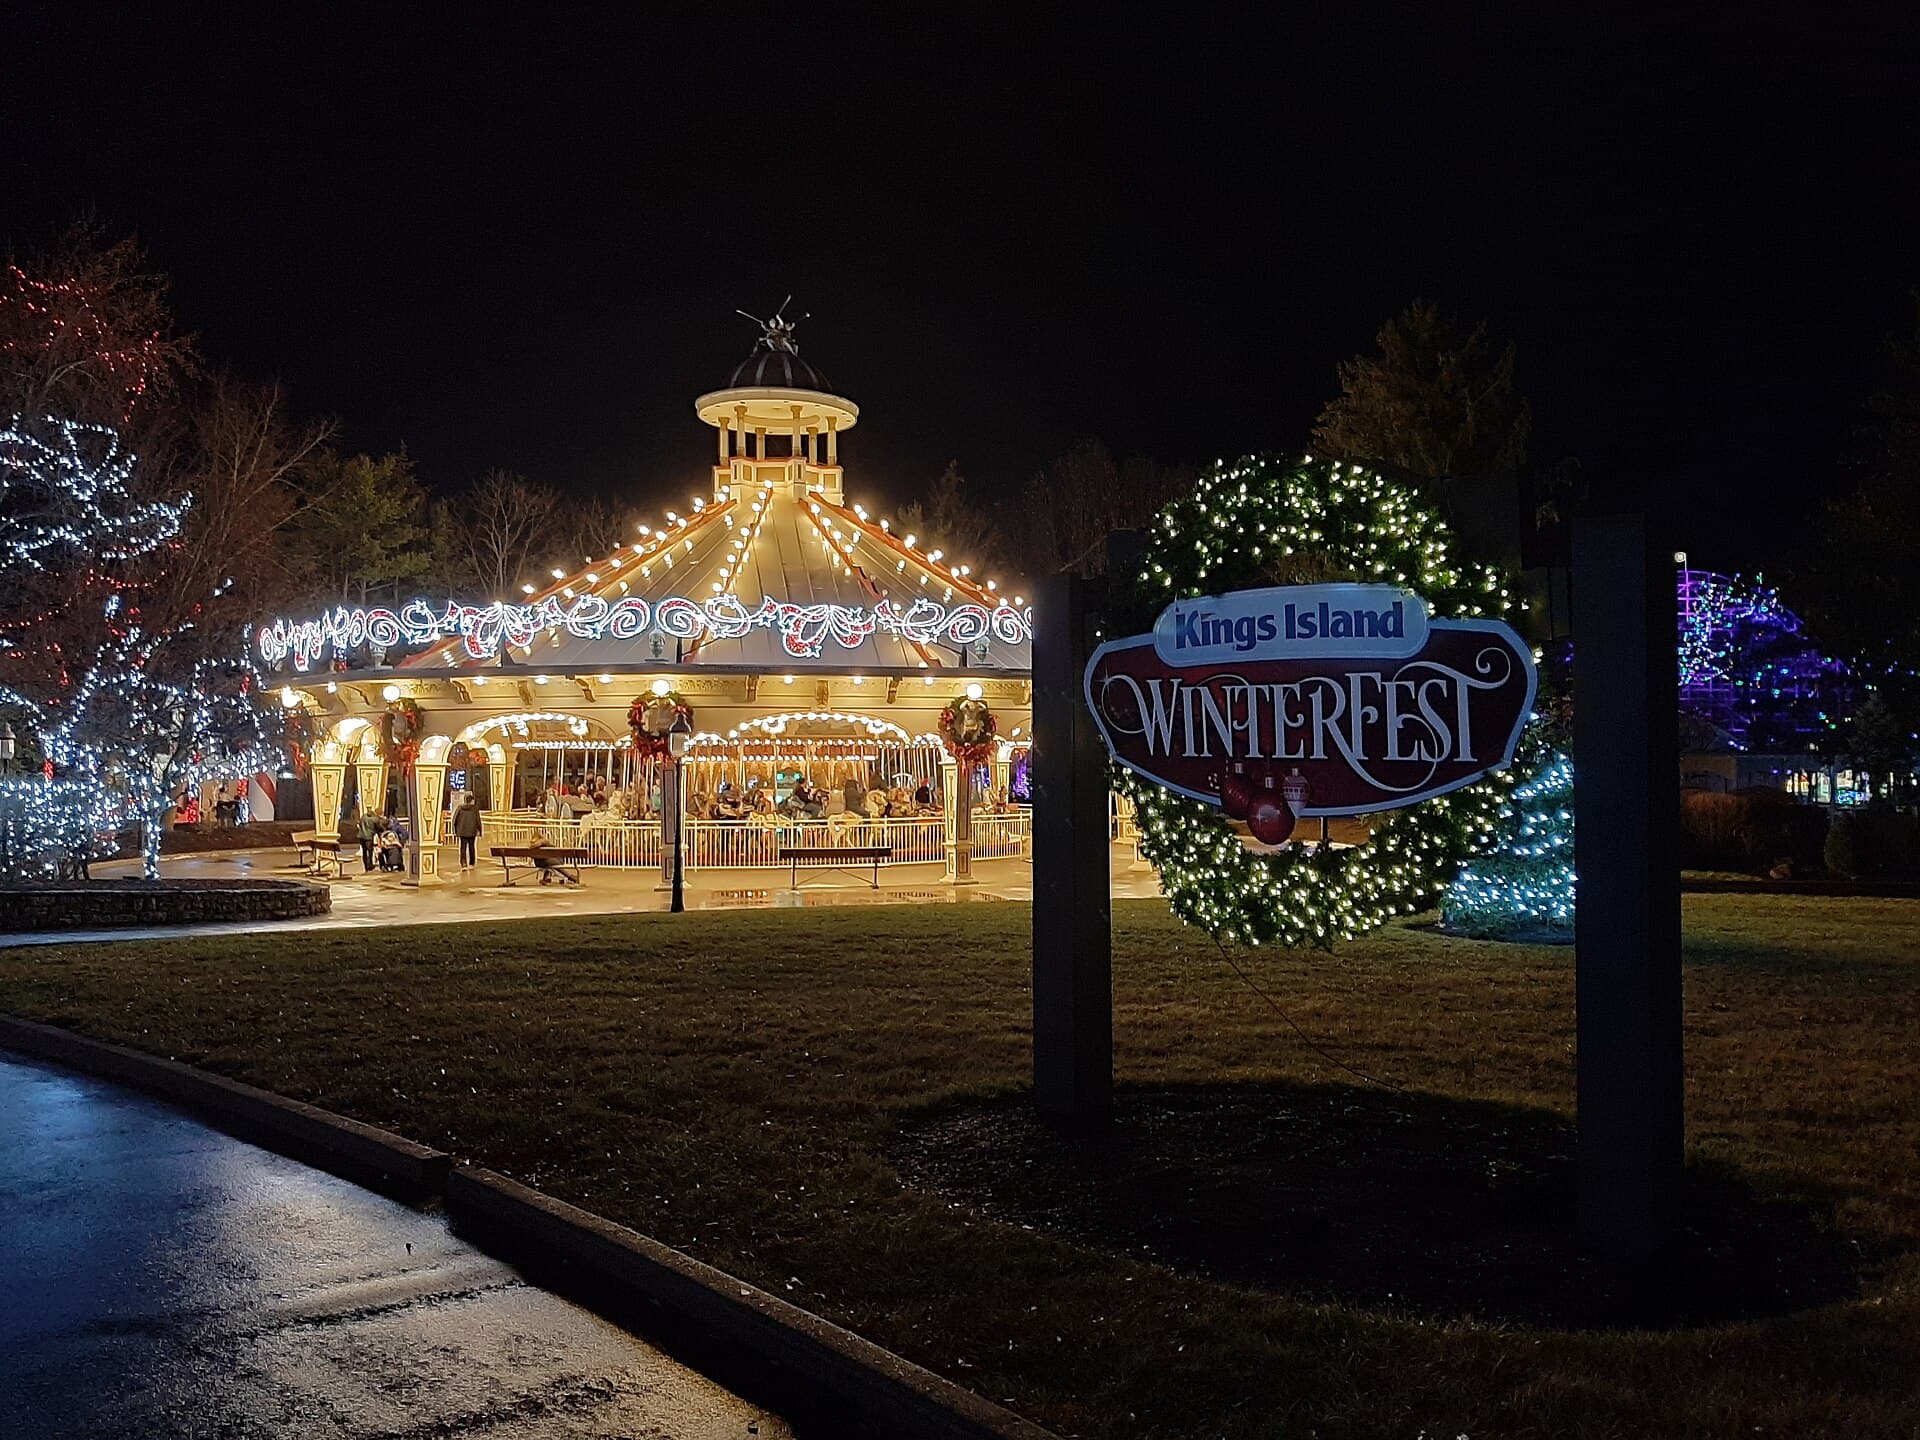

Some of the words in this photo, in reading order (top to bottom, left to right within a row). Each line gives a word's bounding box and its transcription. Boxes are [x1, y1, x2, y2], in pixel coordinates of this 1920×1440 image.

[1175, 607, 1278, 651] Kings
[1284, 601, 1404, 640] Island
[1102, 649, 1511, 790] WINTERFEST
